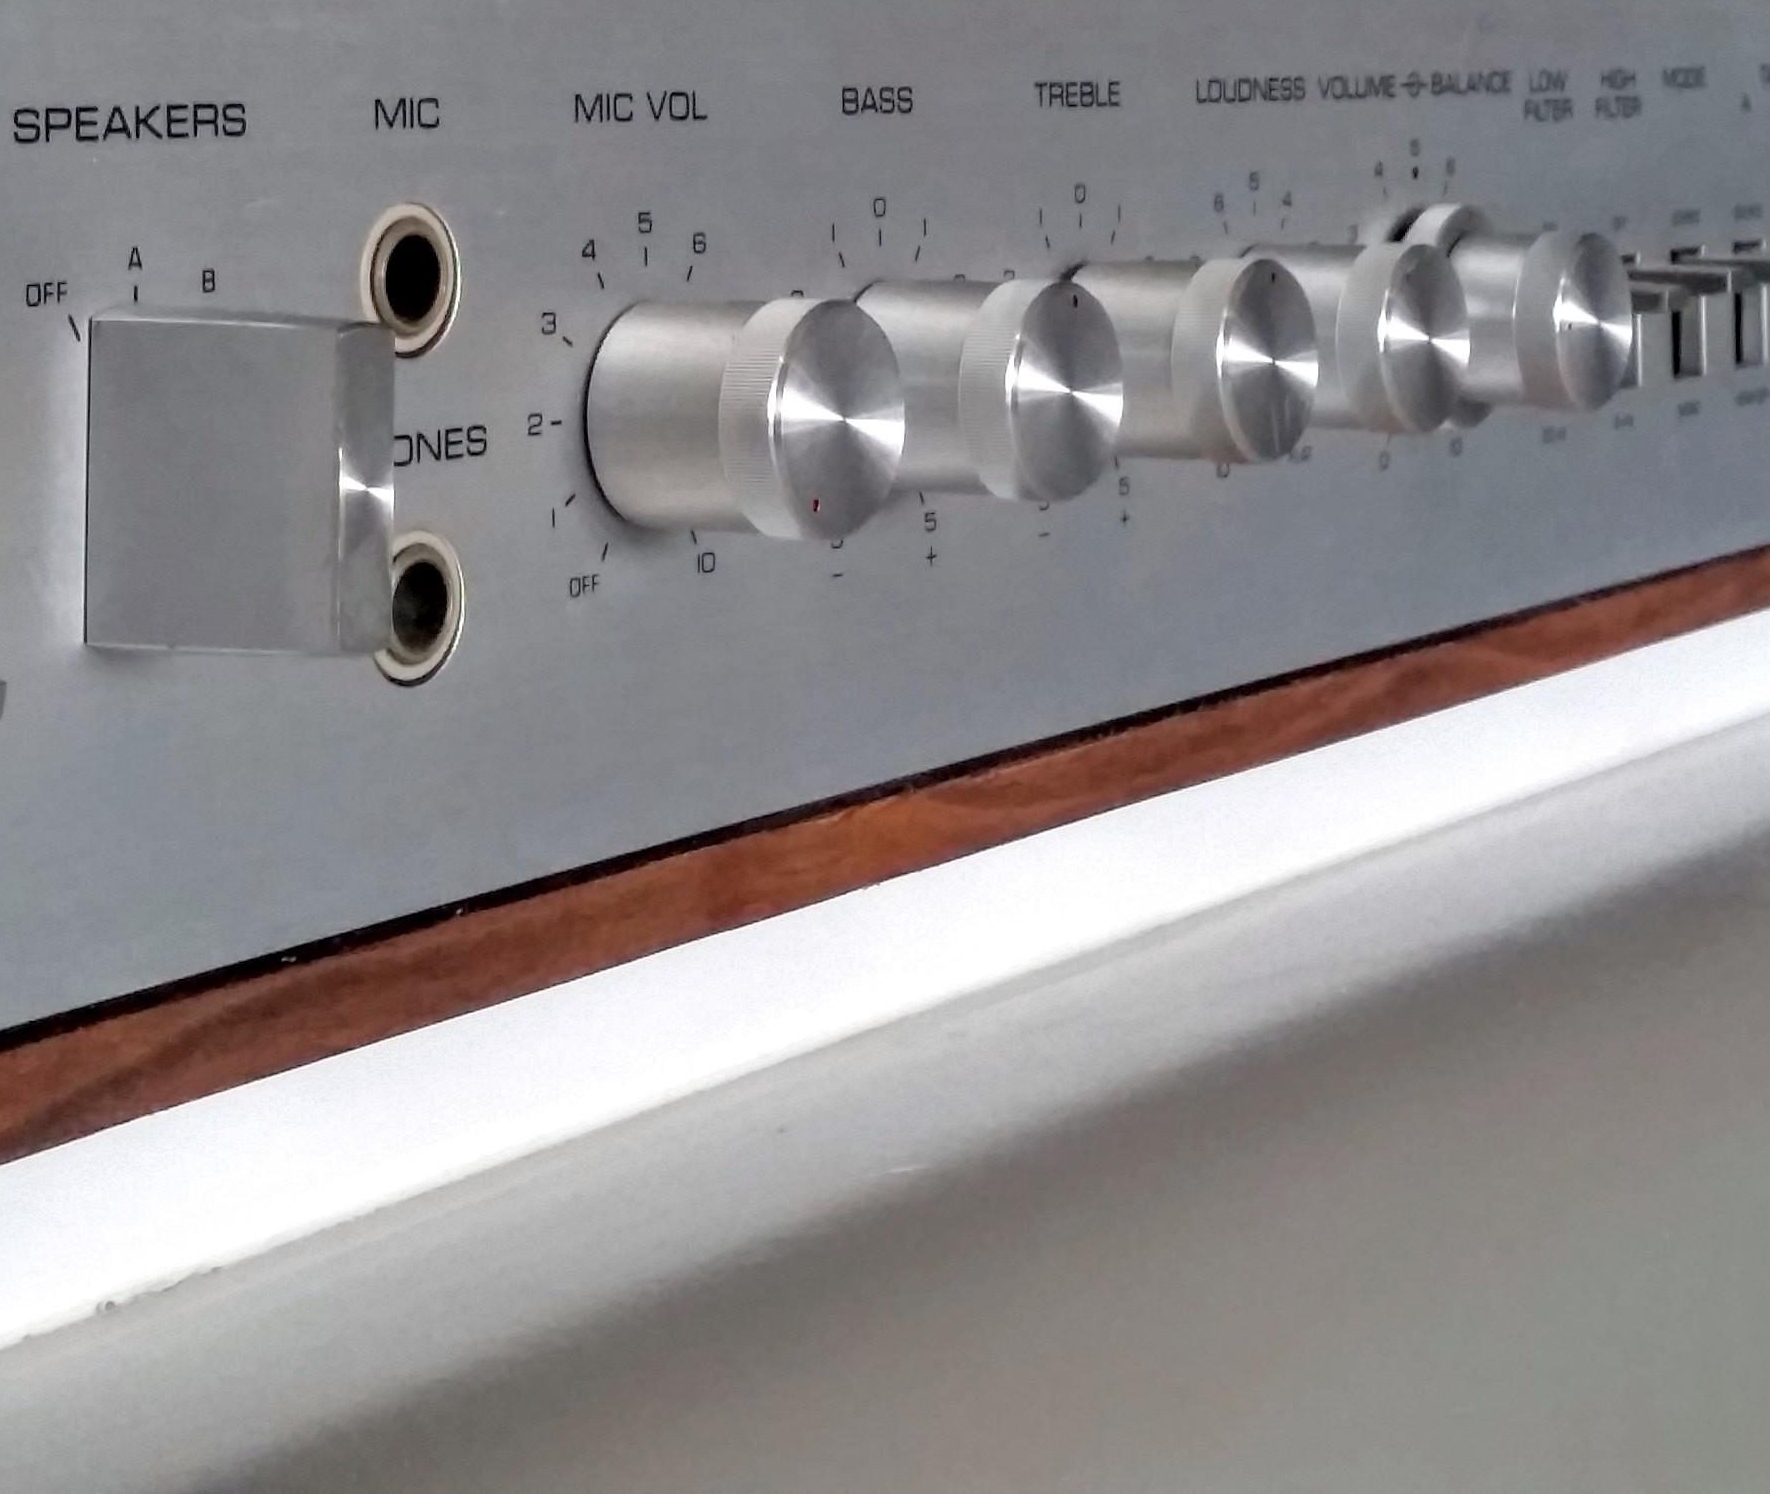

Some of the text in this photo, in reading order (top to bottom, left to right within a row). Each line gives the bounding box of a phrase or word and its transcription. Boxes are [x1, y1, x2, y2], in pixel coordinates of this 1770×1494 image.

[841, 86, 914, 116] BASS
[1034, 80, 1120, 108] TREBLE
[1195, 76, 1306, 105] LOUDNESS
[1317, 74, 1397, 101] VOLUME
[374, 97, 440, 130] MIC
[574, 90, 708, 123] MIC VOL
[13, 103, 247, 145] SPEAKERS
[1074, 183, 1087, 205] 0
[1246, 170, 1261, 192] 5
[873, 196, 887, 218] 0
[581, 211, 707, 261] 4 5 6
[25, 246, 216, 308] OFF A B
[541, 311, 557, 336] 3
[527, 412, 543, 437] 2
[393, 425, 488, 467] ONES
[924, 511, 937, 533] 5
[569, 551, 716, 598] OFF 10
